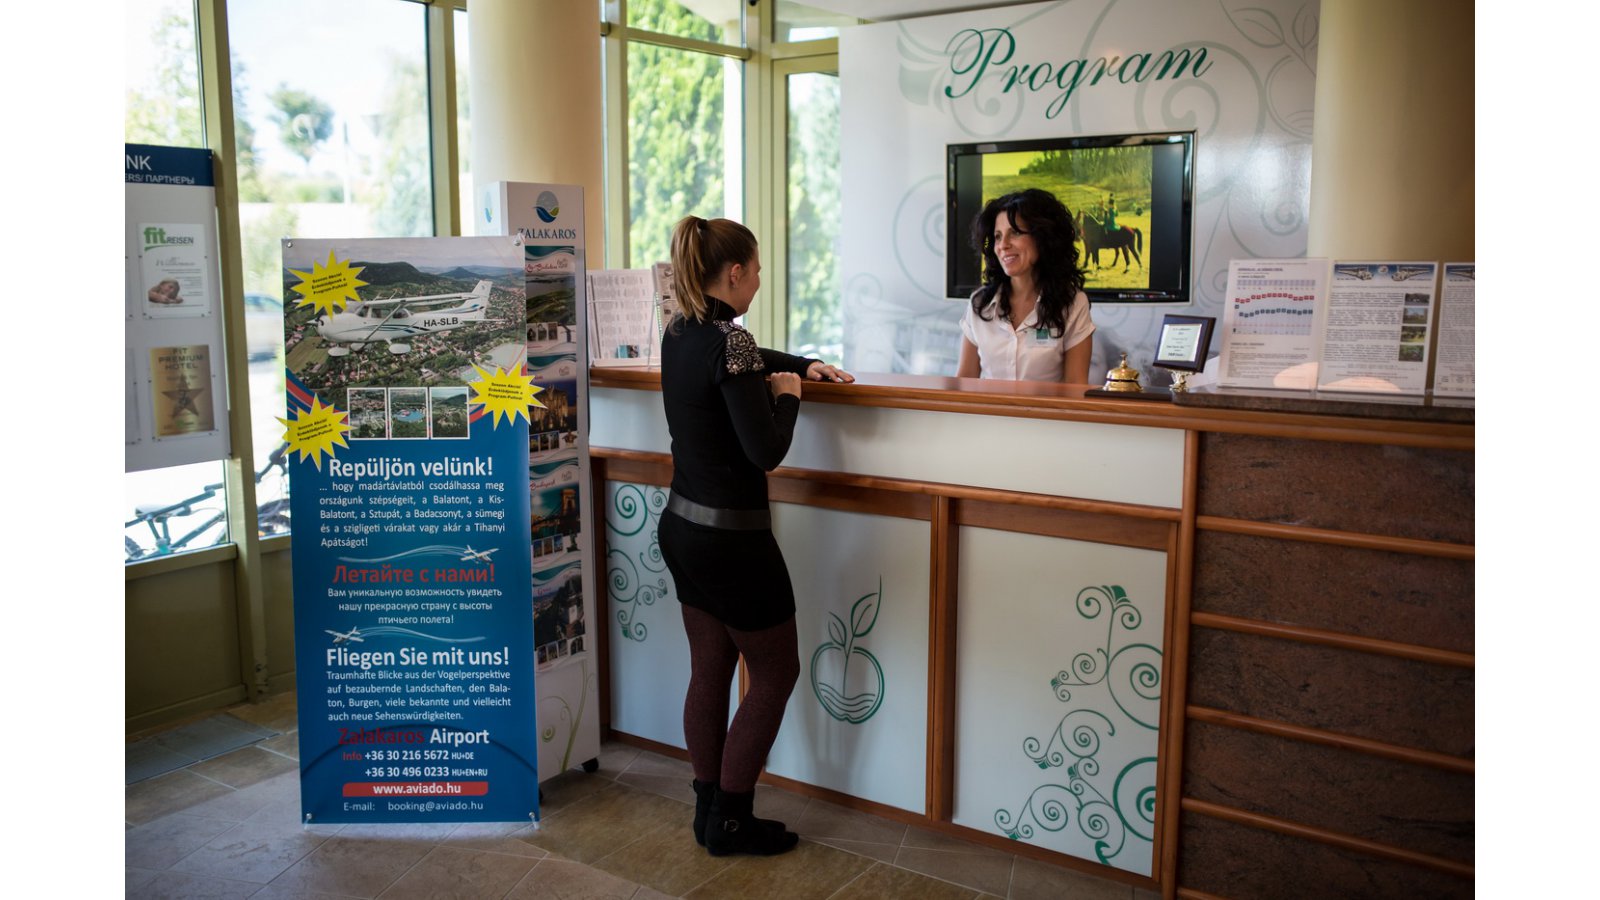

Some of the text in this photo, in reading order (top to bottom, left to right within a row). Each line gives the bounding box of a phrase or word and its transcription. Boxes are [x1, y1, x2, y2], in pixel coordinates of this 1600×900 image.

[945, 28, 1212, 120] Program
[146, 174, 194, 184] ПАРТНЕРЫ
[144, 227, 194, 244] fit REISEN
[424, 317, 458, 327] HA-SLB
[158, 354, 203, 363] PREMIUM
[329, 457, 493, 481] Repüljön velünk!
[332, 481, 354, 492] hogy
[359, 481, 425, 491] madártávlatból
[429, 481, 480, 490] csodálhassa
[485, 483, 504, 491] meg
[320, 496, 363, 507] országunk
[369, 495, 416, 506] szépségeit,
[433, 495, 471, 504] Balatont,
[489, 495, 504, 504] Kis-
[320, 510, 357, 519] Balatont,
[369, 509, 402, 520] Sztupát,
[414, 509, 464, 519] Badacsonyt,
[475, 509, 504, 519] sümegi
[320, 524, 330, 533] és
[344, 524, 380, 534] szigligeti
[384, 523, 415, 532] várakat
[419, 525, 439, 534] vagy
[443, 523, 461, 532] akár
[474, 523, 505, 533] Tihanyi
[321, 537, 367, 548] Apátságot!
[333, 564, 494, 583] Летайте с нами!
[328, 588, 346, 597] Вам
[348, 590, 403, 598] уникальную
[466, 589, 502, 597] увидеть
[339, 604, 362, 612] нашу
[365, 603, 419, 612] прекрасную
[421, 603, 450, 611] страну
[378, 615, 453, 625] птичьего полета!
[326, 647, 508, 669] Fliegen Sie mit uns!
[327, 670, 376, 680] Traumhafte
[378, 670, 403, 679] Blicke
[421, 670, 436, 679] der
[437, 670, 510, 680] Vogelperspektive
[327, 683, 510, 693] auf bezaubernde Landschaften, den Bala-
[328, 697, 511, 708] ton, Burgen, viele bekannte und vielleicht
[328, 712, 349, 721] auch
[375, 711, 463, 722] Sehenswürdigkeiten.
[338, 727, 489, 747] Zalakaros Airport
[342, 751, 363, 760] Info
[365, 751, 384, 760] +36
[387, 751, 399, 760] 30
[402, 750, 421, 760] 216
[424, 750, 449, 760] 5672
[365, 767, 384, 777] +36
[387, 767, 400, 777] 30
[402, 767, 421, 776] 496
[424, 767, 449, 776] 0233
[373, 782, 461, 794] www.aviado.hu
[344, 801, 483, 812] E-mail: booking@aviado.hu
